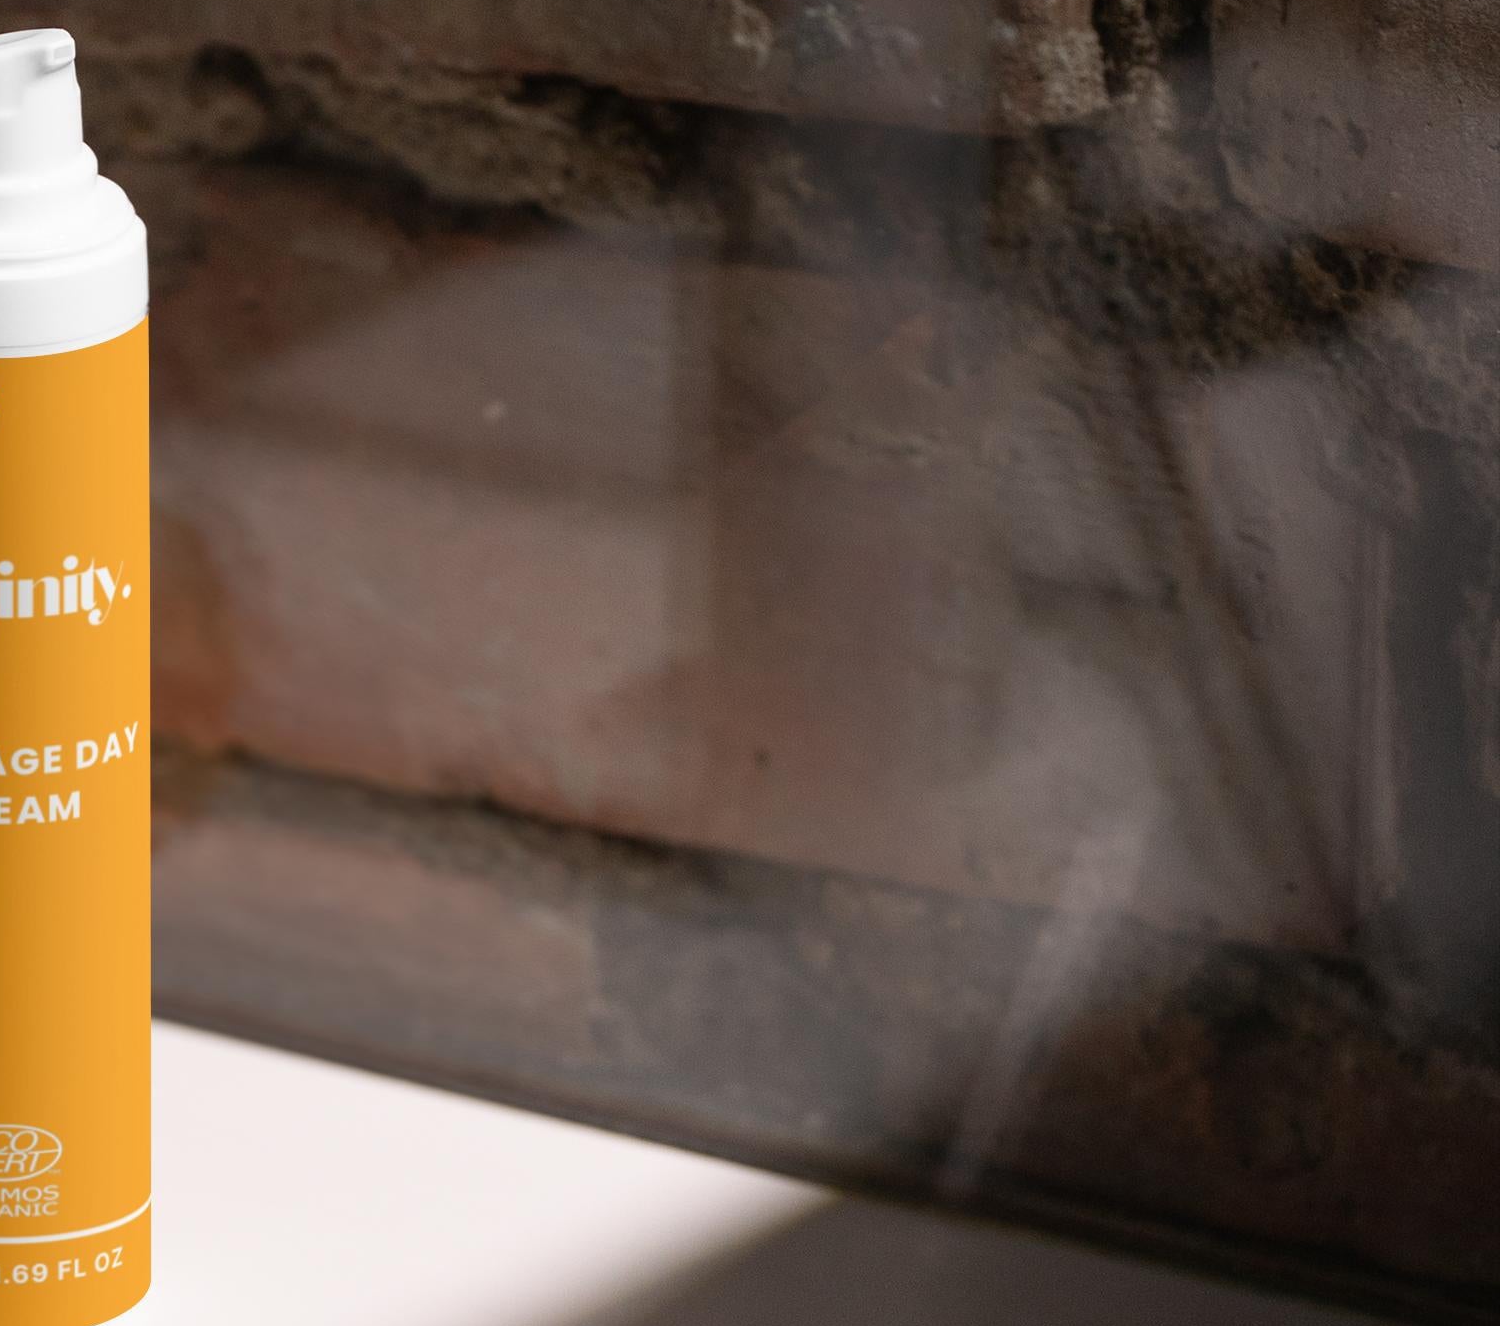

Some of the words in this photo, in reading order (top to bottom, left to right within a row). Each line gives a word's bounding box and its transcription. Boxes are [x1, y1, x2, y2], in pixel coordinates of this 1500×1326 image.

[76, 721, 139, 770] DAY
[57, 1258, 87, 1281] FL
[94, 1246, 124, 1273] OZ
